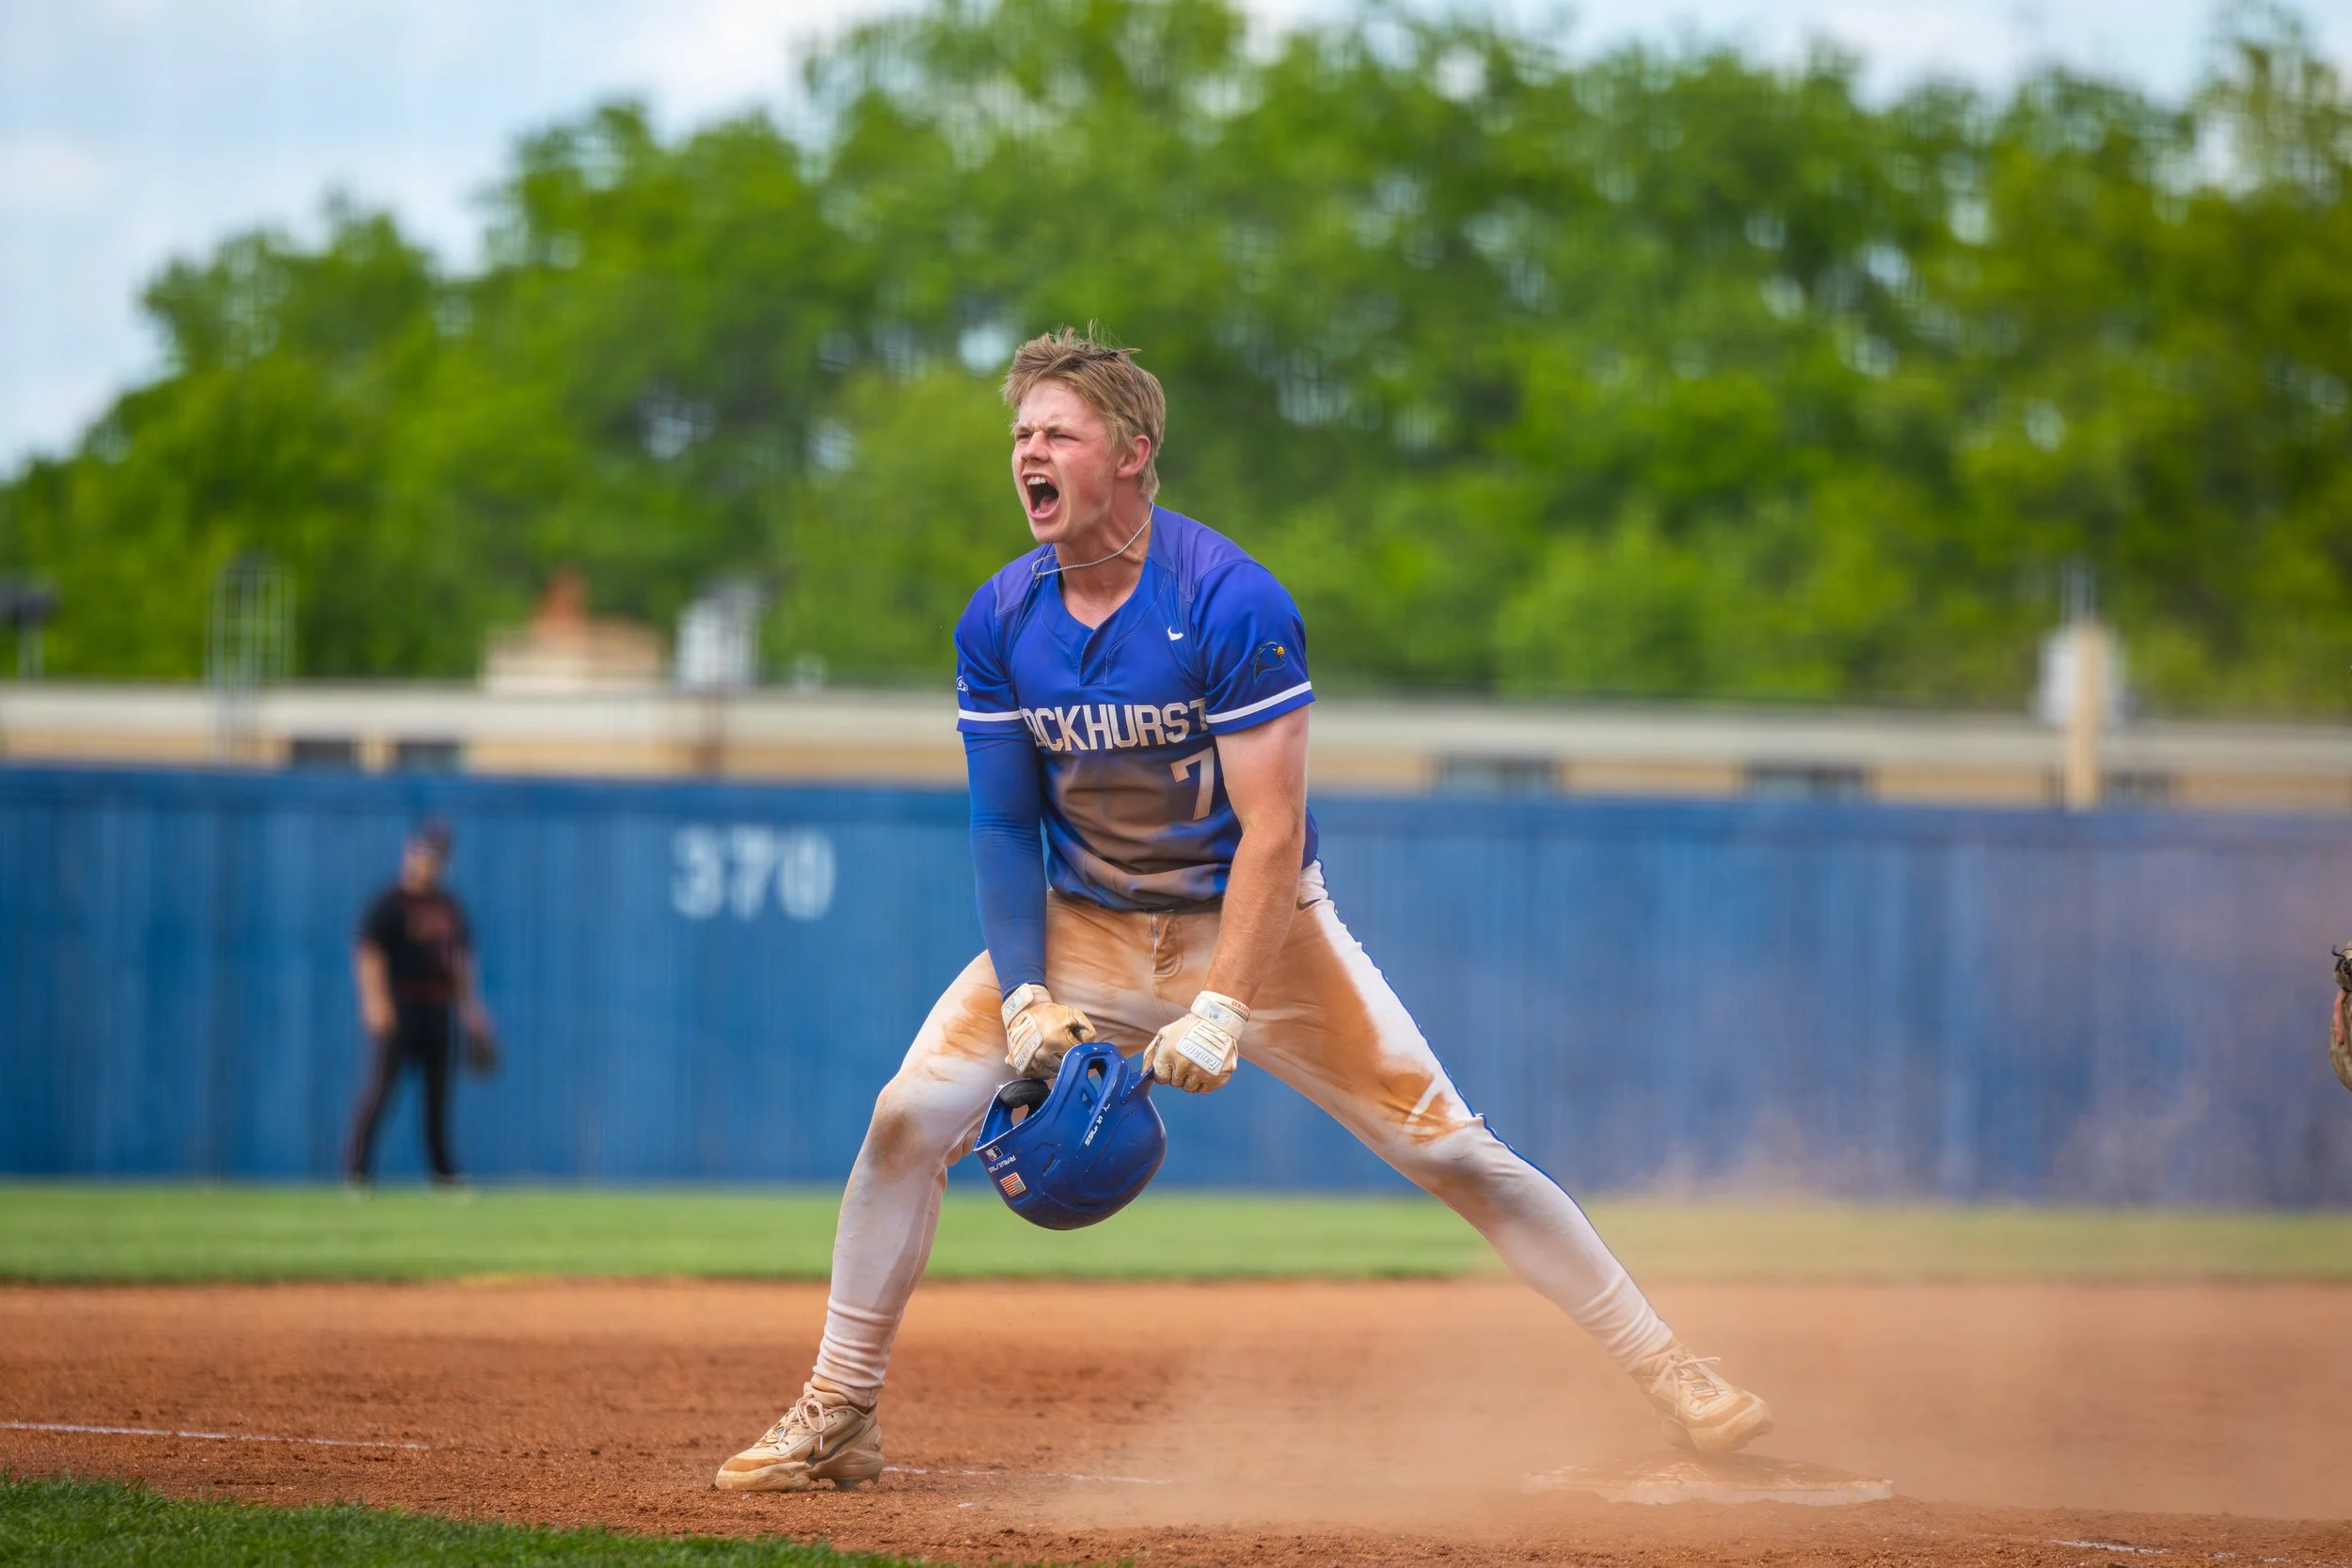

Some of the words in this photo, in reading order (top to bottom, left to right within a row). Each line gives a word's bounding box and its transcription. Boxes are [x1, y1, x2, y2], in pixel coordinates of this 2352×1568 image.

[1020, 698, 1207, 752] OCKHURST
[1170, 747, 1215, 820] 7
[671, 824, 835, 921] 370
